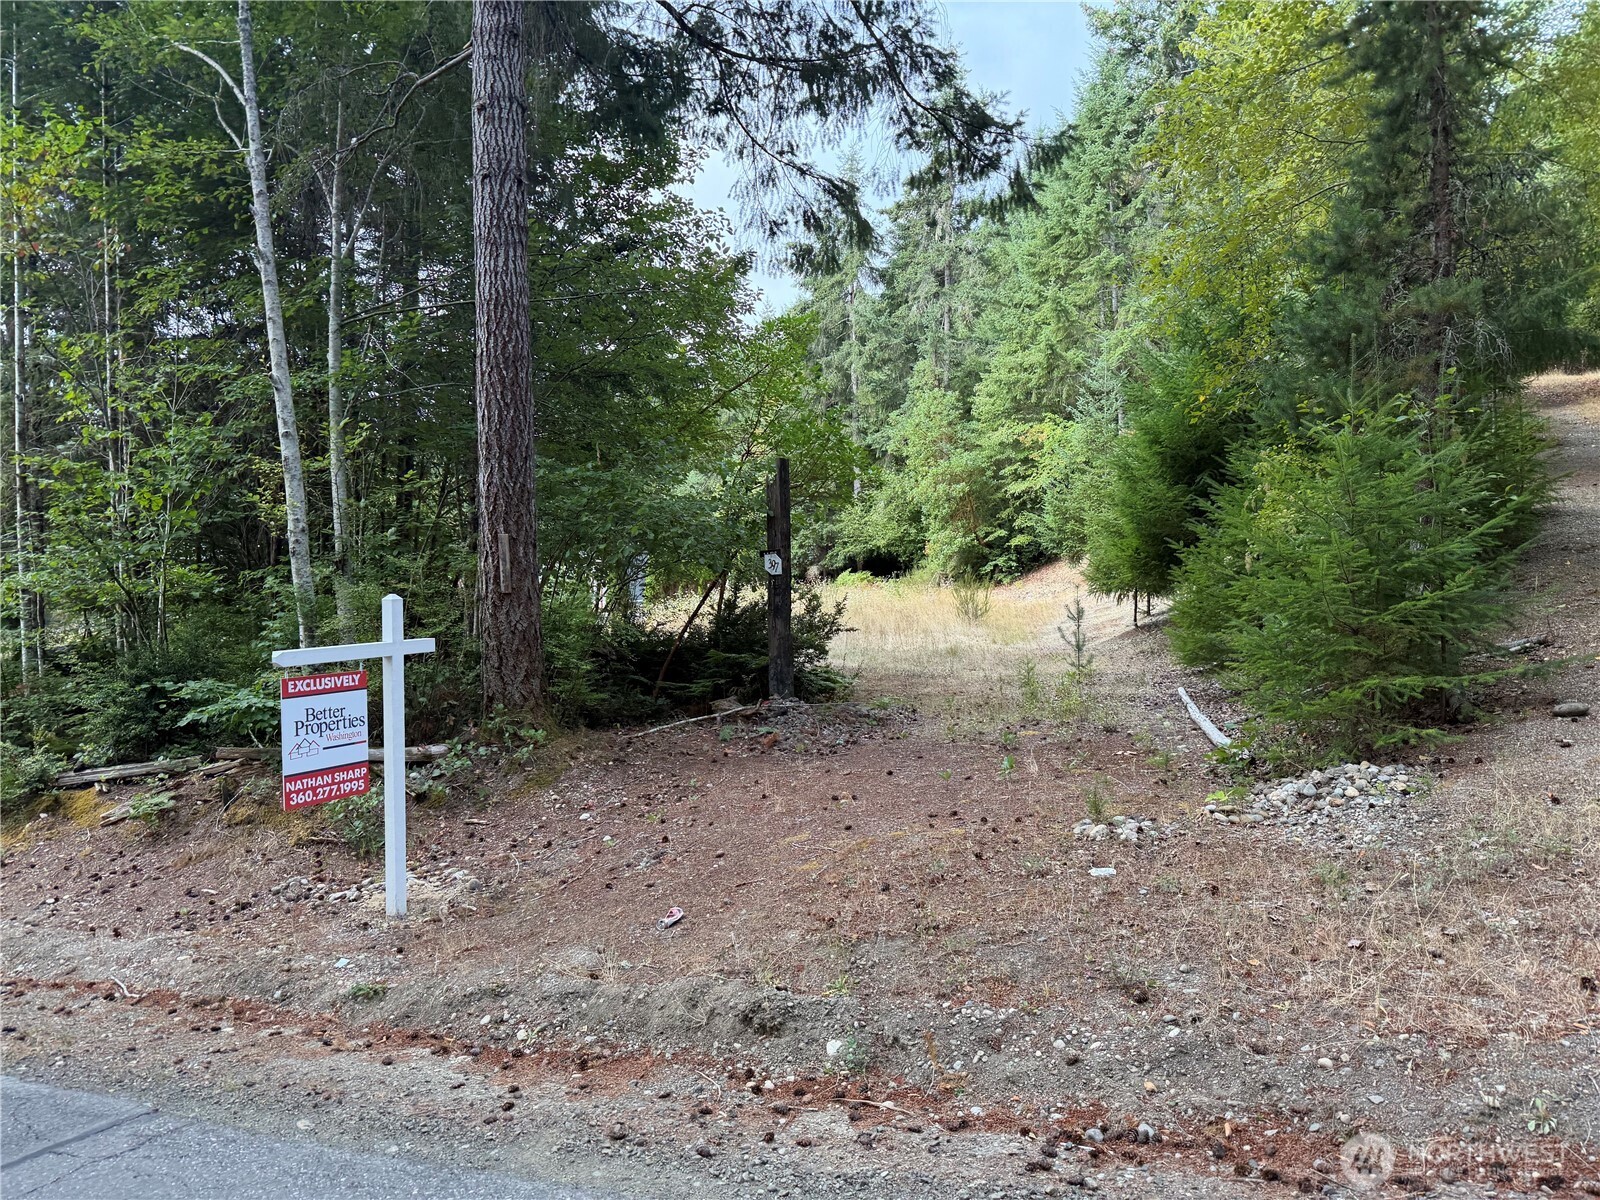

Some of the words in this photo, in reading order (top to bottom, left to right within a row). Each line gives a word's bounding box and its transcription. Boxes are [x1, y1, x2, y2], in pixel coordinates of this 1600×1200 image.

[768, 558, 780, 573] 397
[287, 674, 361, 693] EXCLUSIVELY
[305, 706, 346, 723] Better
[294, 714, 366, 738] Properties
[325, 730, 362, 742] Washington
[285, 774, 332, 793] NATHAN
[333, 767, 368, 783] SHARP
[289, 779, 365, 805] 360.277.1995
